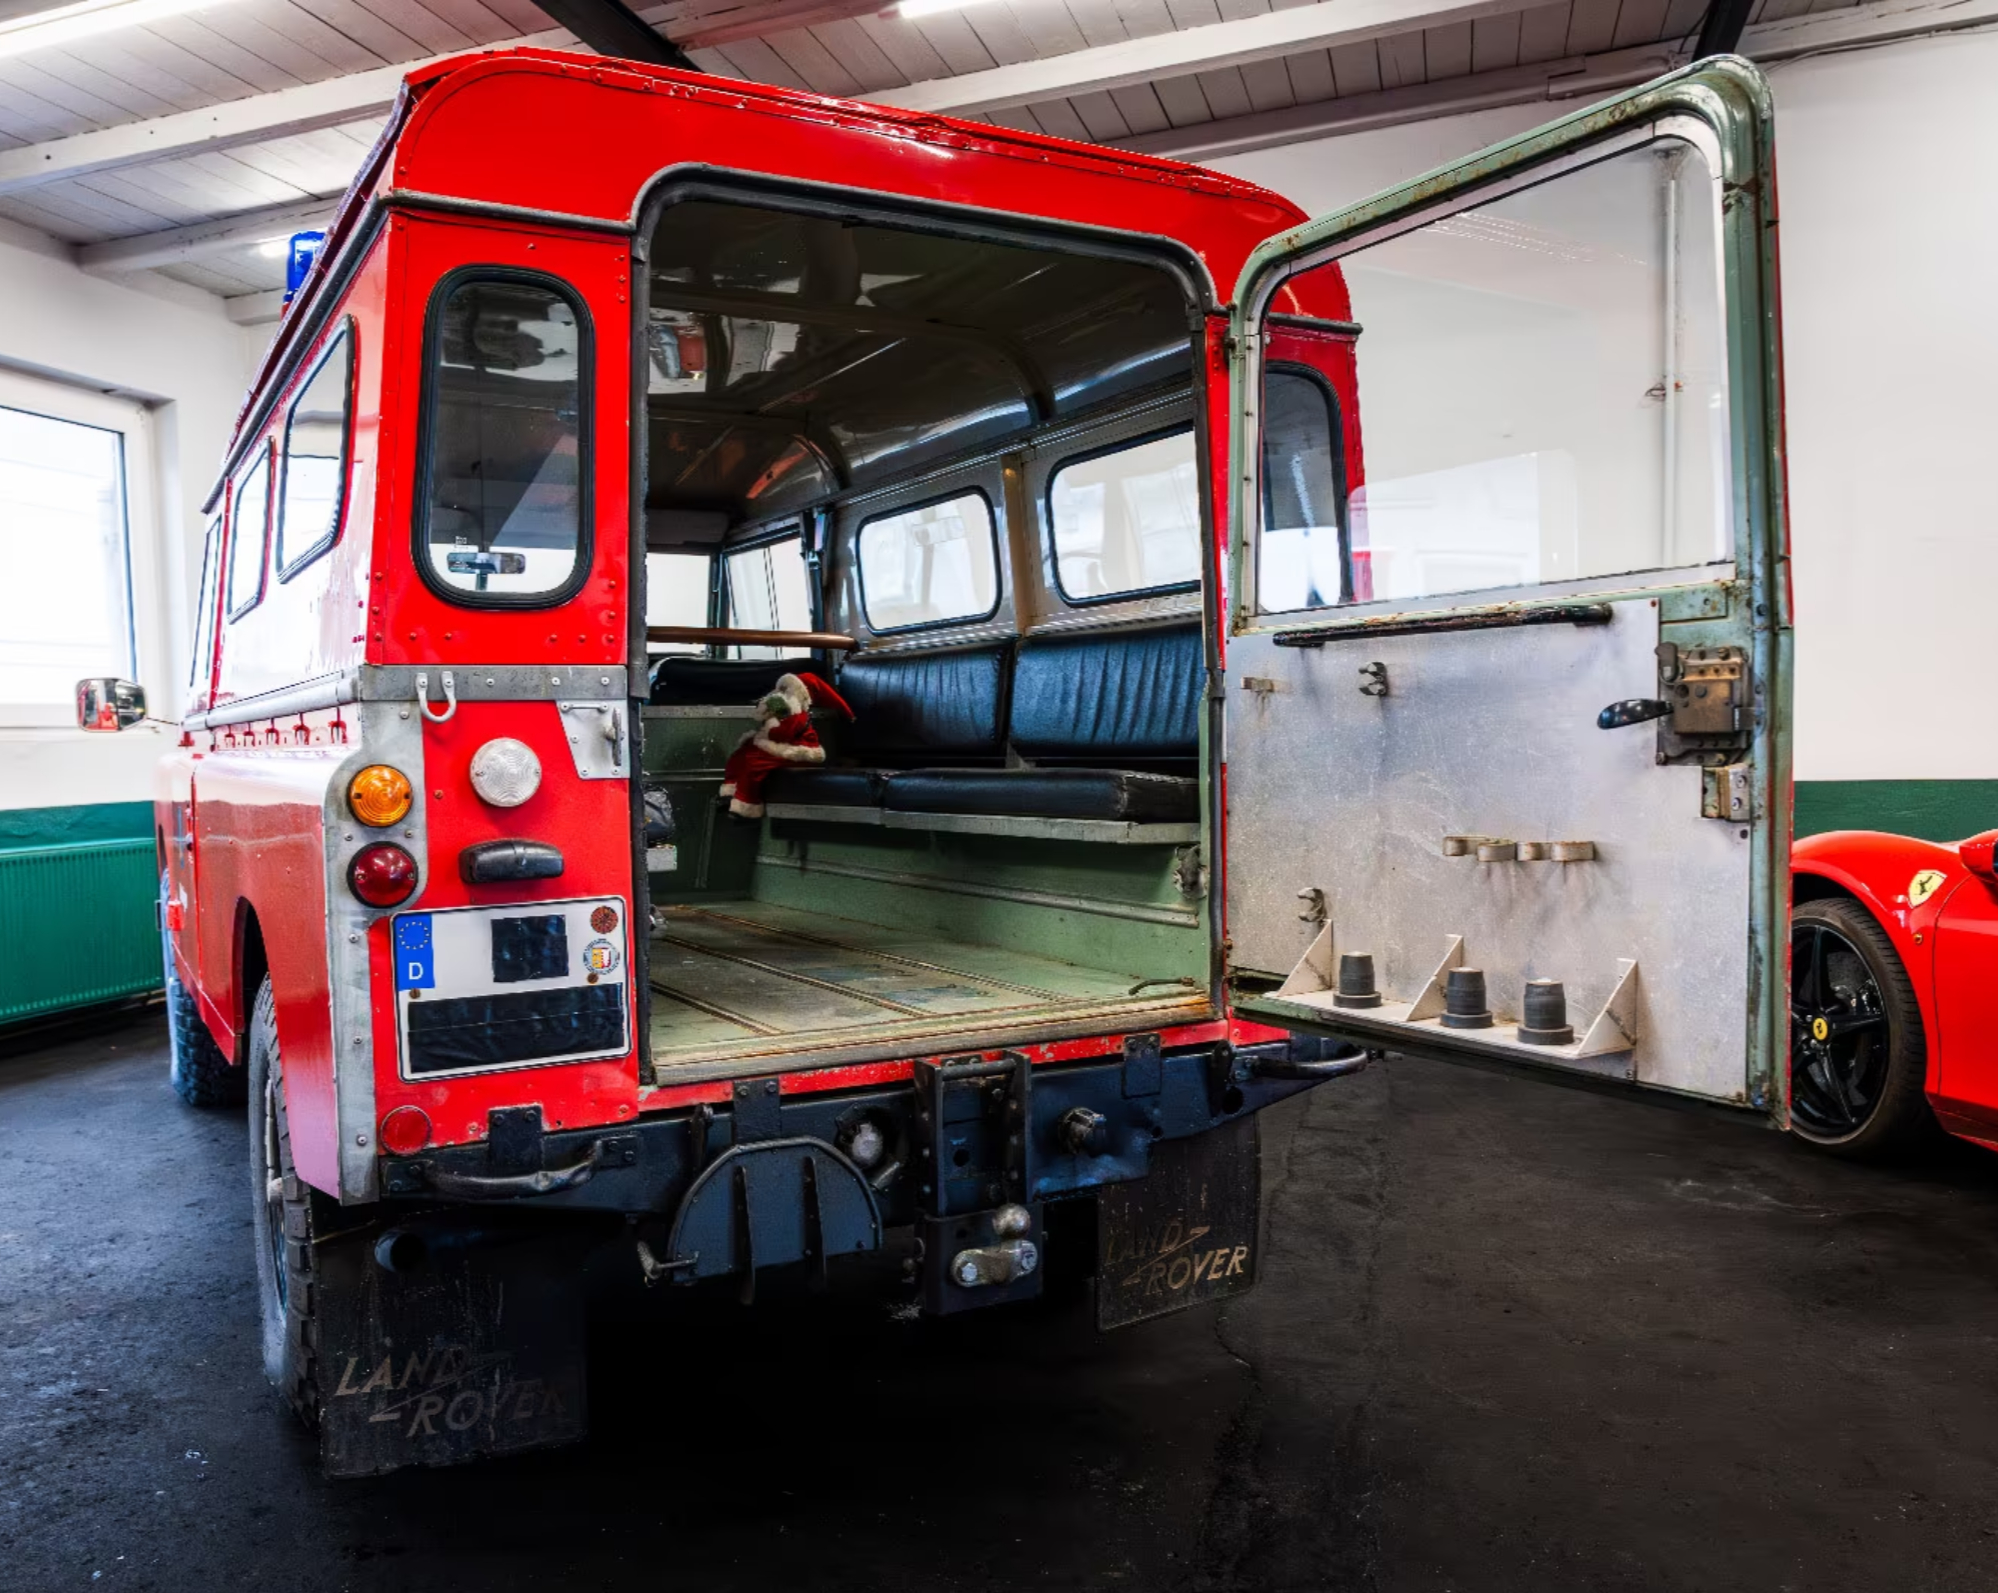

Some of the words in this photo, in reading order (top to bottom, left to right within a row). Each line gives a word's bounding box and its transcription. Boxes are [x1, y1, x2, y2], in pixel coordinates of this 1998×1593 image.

[408, 962, 424, 980] D
[1145, 1246, 1248, 1295] ROVER
[334, 1345, 468, 1397] LAND
